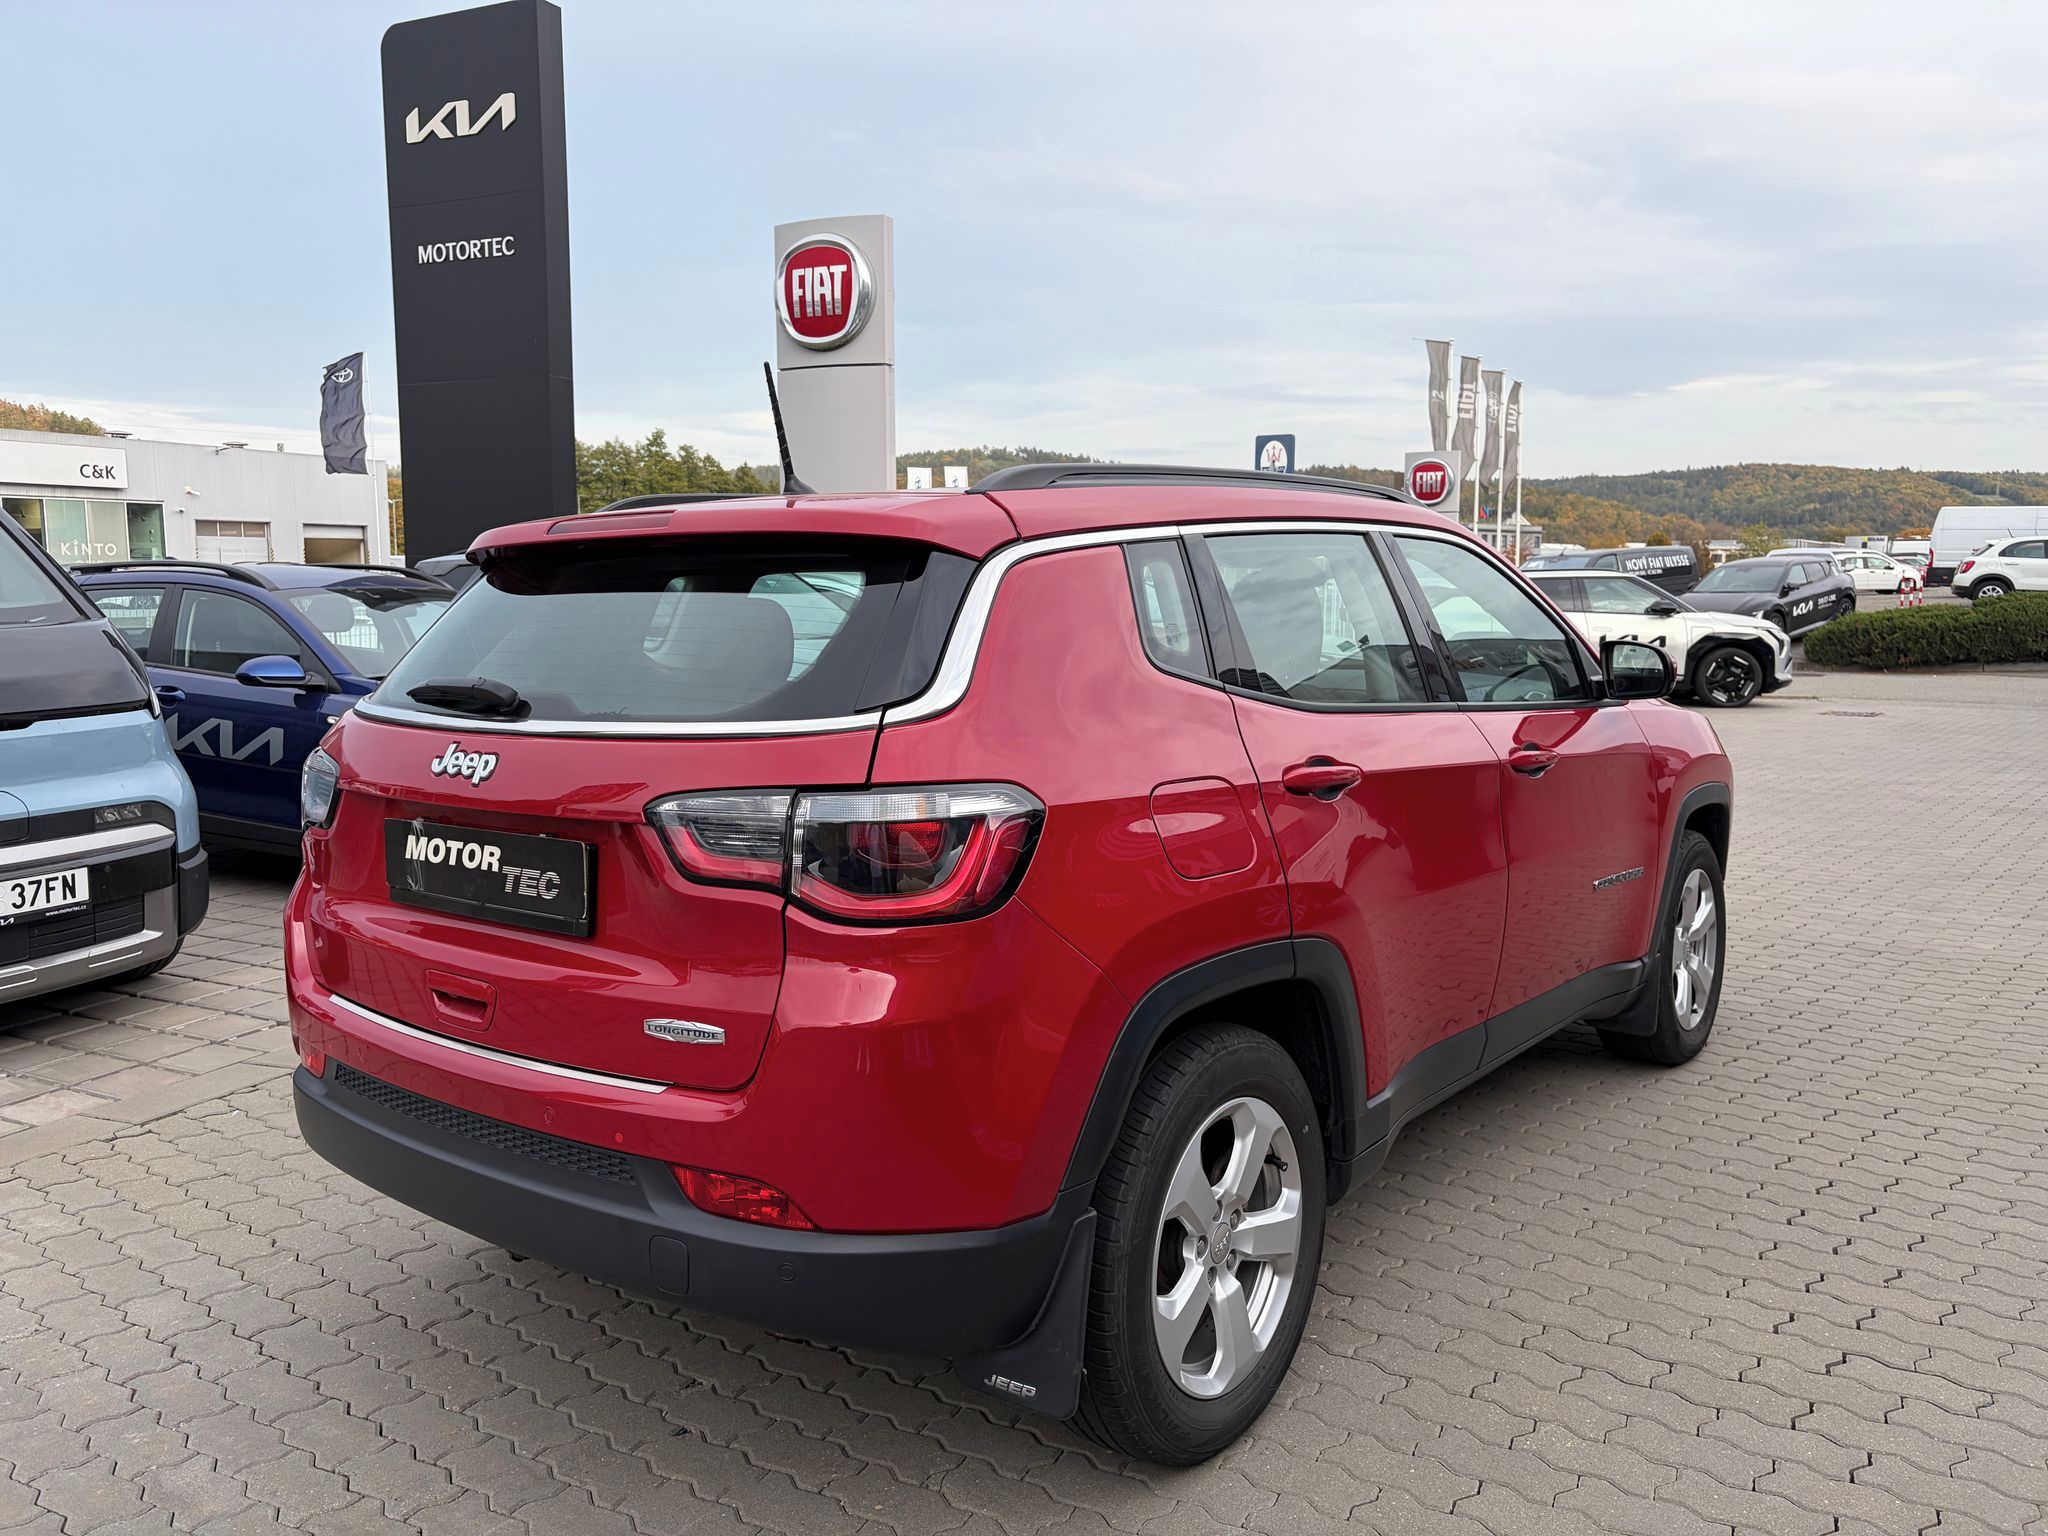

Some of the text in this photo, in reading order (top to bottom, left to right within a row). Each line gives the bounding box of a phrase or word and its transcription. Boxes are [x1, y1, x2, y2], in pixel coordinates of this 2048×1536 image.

[405, 92, 516, 144] KIA
[418, 236, 515, 264] MOTORTEC
[792, 264, 847, 318] FIAT
[79, 463, 116, 480] C&K
[1415, 471, 1444, 494] FIAT
[1625, 554, 1690, 571] NOVÝ FIAT ULYSSE
[1792, 599, 1814, 617] KIA
[165, 711, 284, 766] KIA
[431, 742, 498, 786] Jeep
[405, 834, 561, 900] MOTOR TEC
[10, 873, 76, 909] 37FN
[647, 1024, 719, 1040] LONGITUDE
